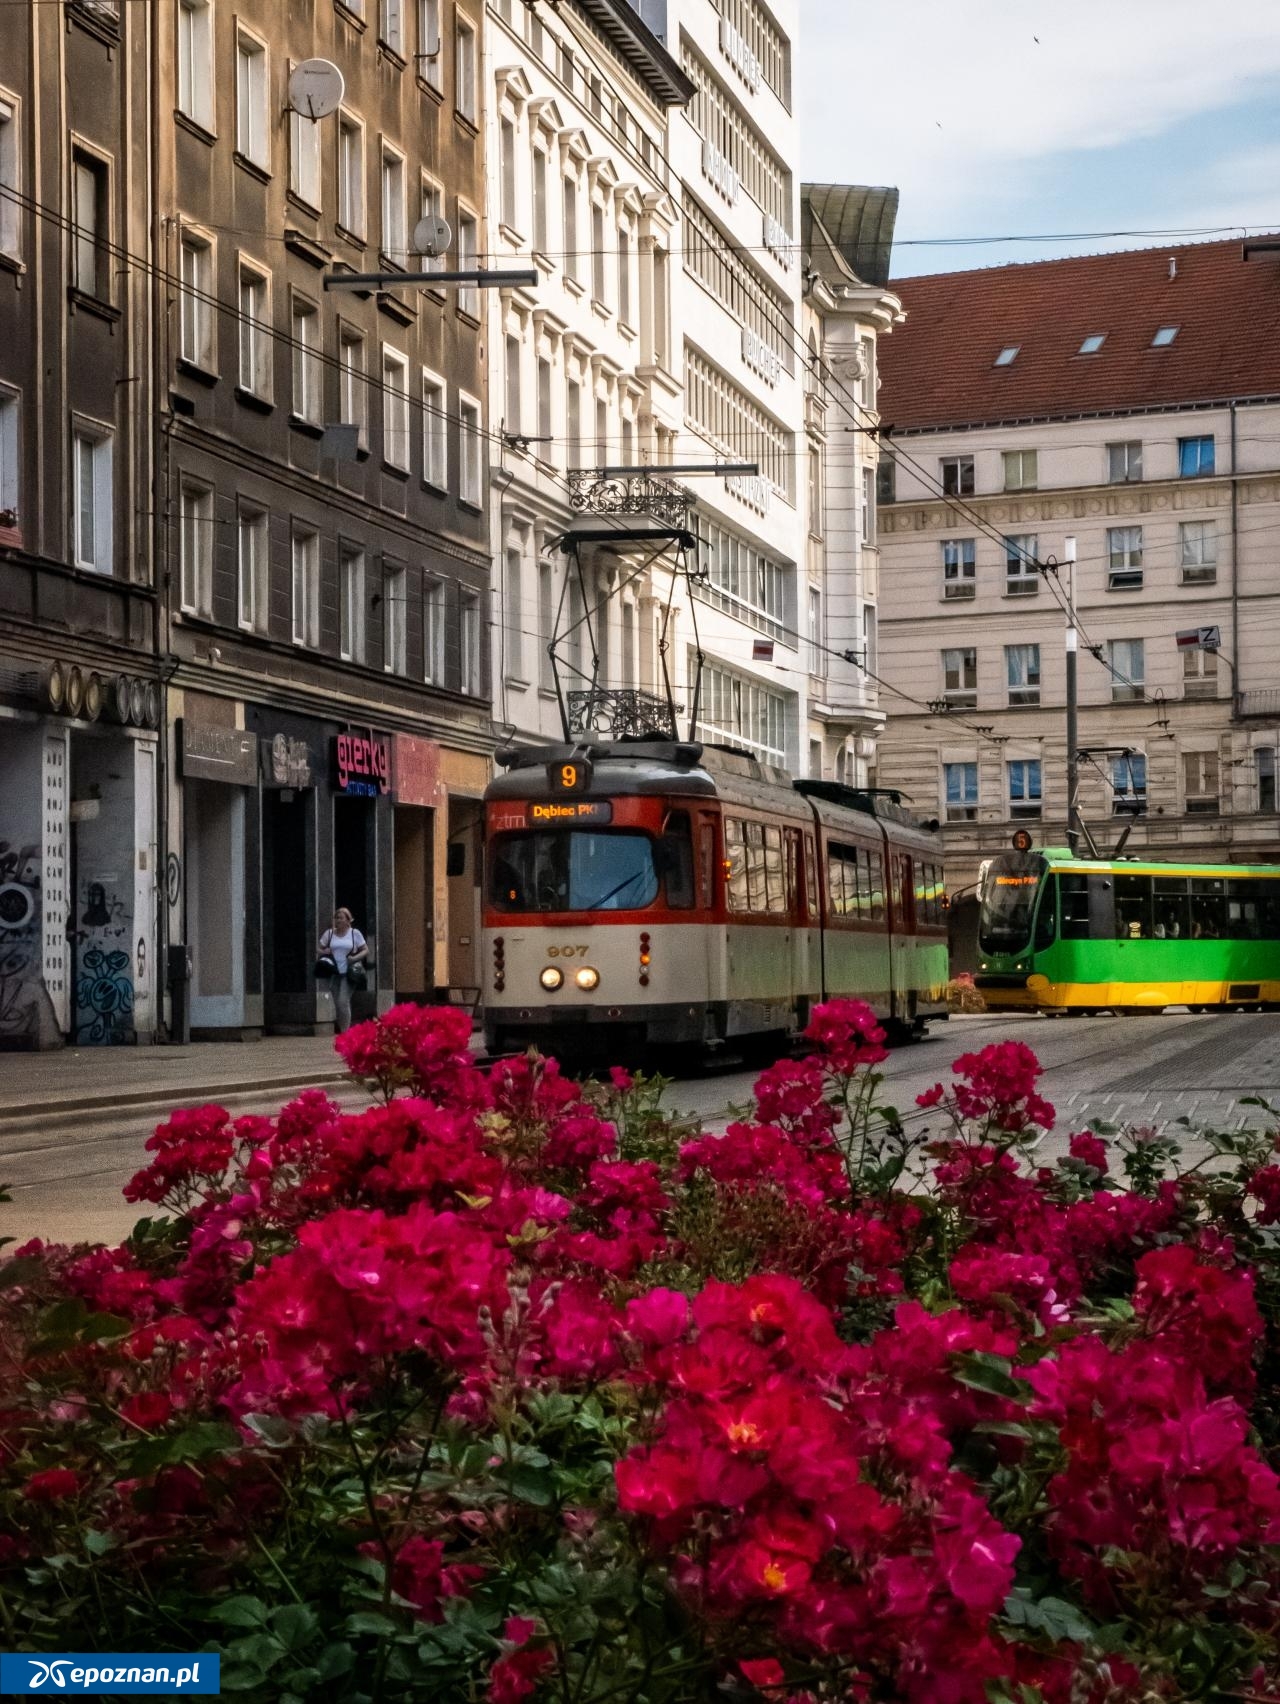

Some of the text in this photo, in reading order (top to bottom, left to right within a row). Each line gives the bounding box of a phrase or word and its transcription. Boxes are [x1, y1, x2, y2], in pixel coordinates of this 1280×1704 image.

[562, 765, 576, 787] 9
[533, 805, 575, 819] Dębiec
[496, 813, 526, 830] ztm
[1018, 833, 1026, 848] 5
[547, 945, 589, 958] 907
